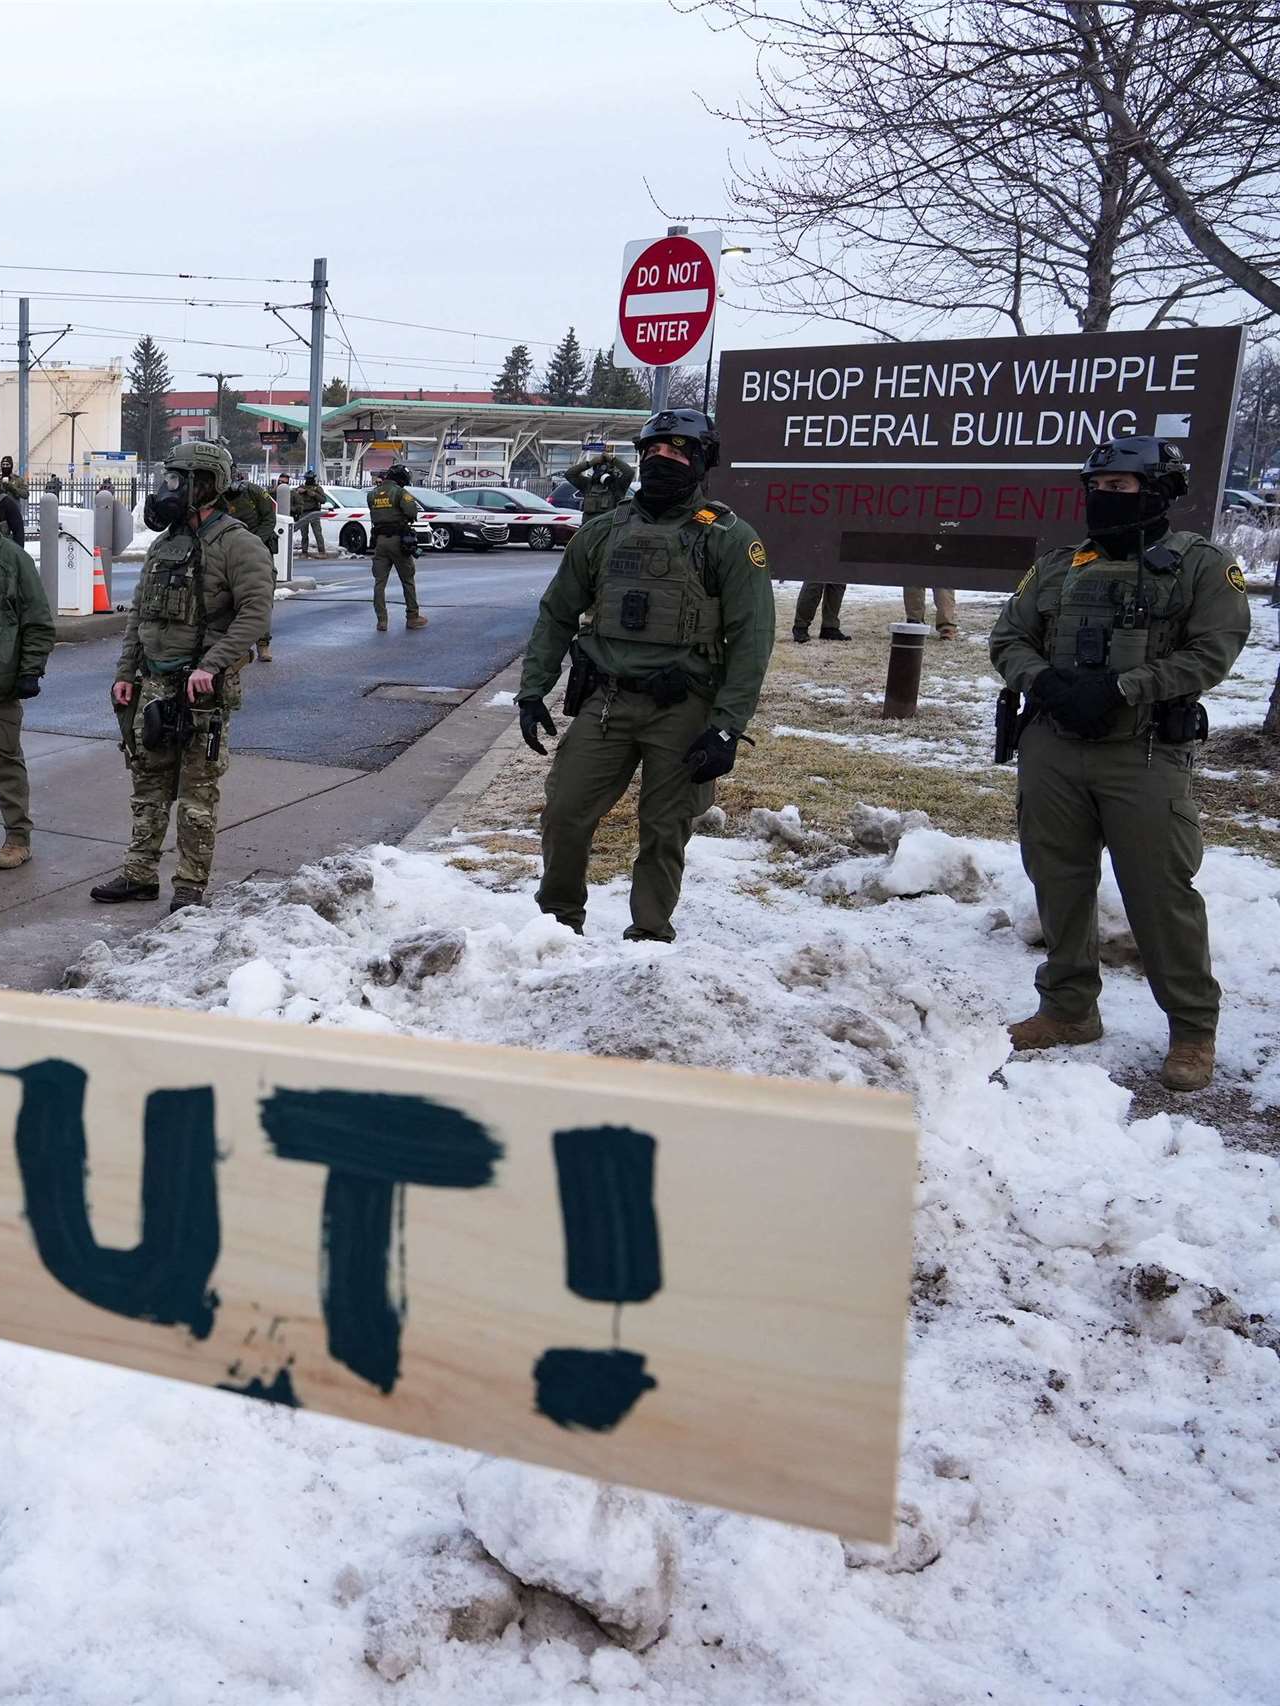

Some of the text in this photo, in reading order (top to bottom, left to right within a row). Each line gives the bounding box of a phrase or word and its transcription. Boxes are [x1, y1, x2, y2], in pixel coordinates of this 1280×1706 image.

[637, 261, 702, 287] DO NOT
[636, 319, 690, 344] ENTER
[741, 354, 1199, 402] BISHOP HENRY WHIPPLE
[784, 408, 1138, 448] FEDERAL BUILDING
[766, 480, 1088, 522] RESTRICTED ENT
